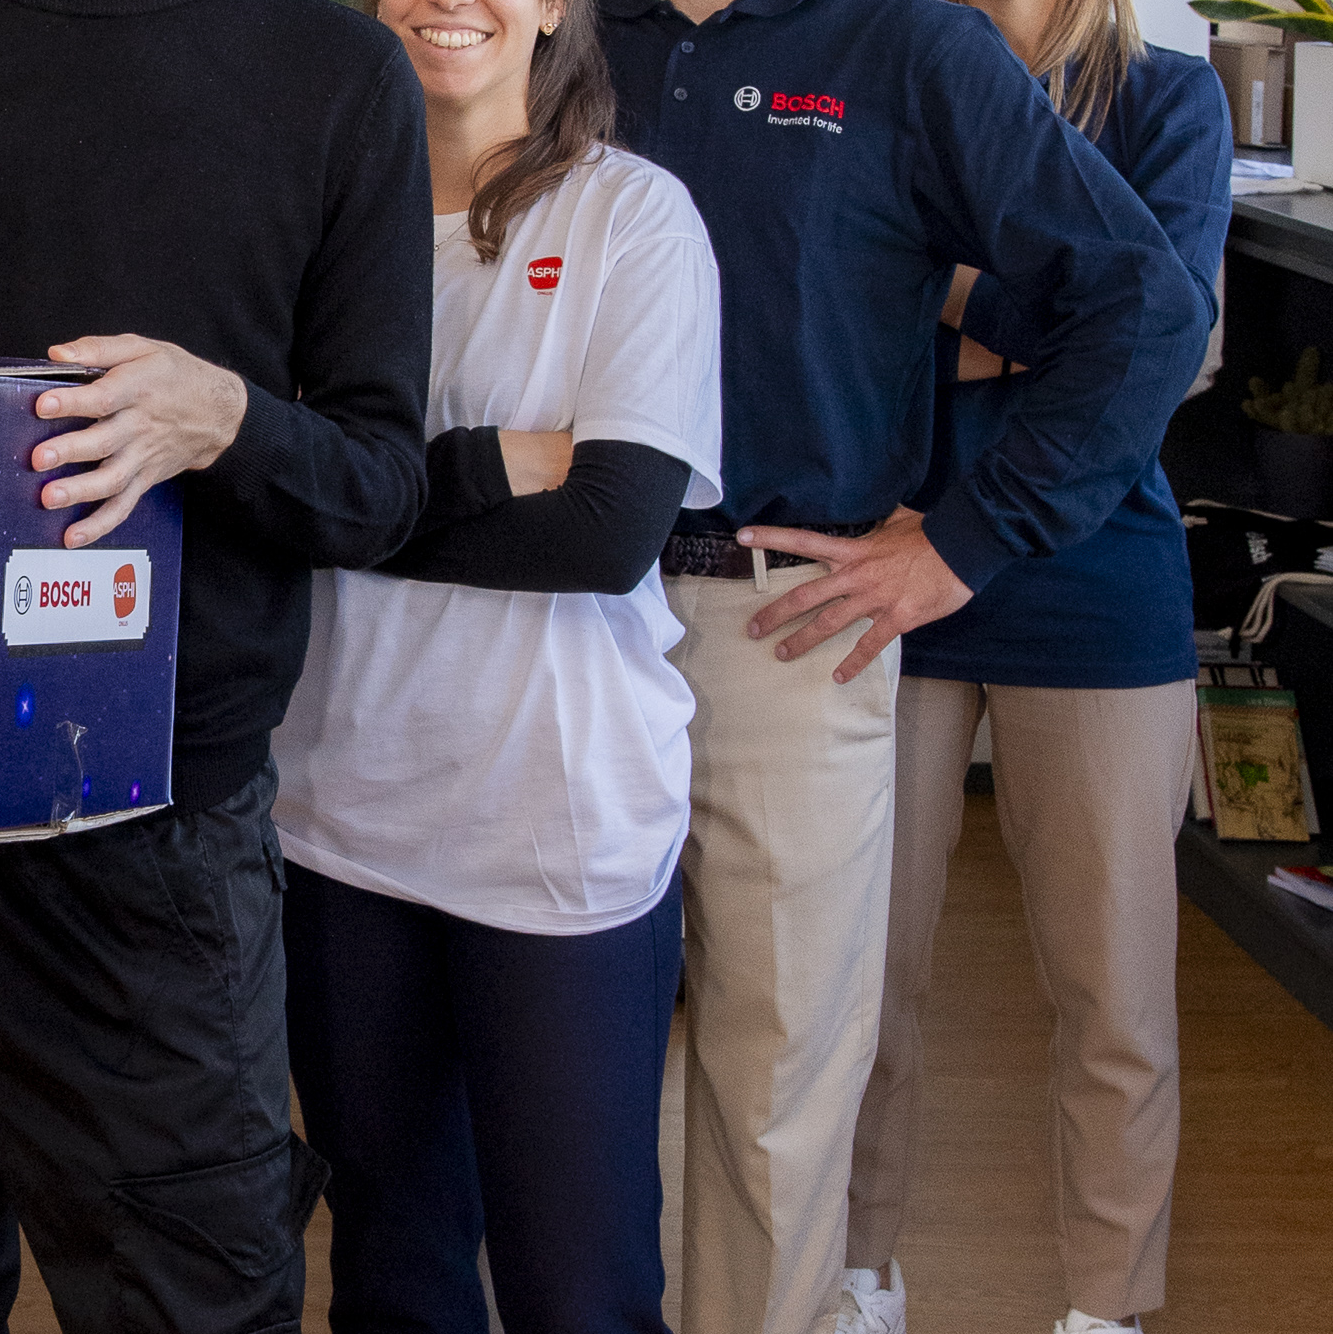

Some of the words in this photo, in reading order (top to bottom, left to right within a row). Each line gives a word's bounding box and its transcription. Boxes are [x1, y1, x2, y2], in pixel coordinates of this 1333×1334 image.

[771, 92, 845, 119] BOSCH
[767, 114, 810, 126] Invented
[813, 117, 827, 129] for
[827, 122, 843, 134] life
[527, 267, 562, 278] ASPH
[39, 580, 92, 608] BOSCH
[113, 581, 136, 599] ASPHI
